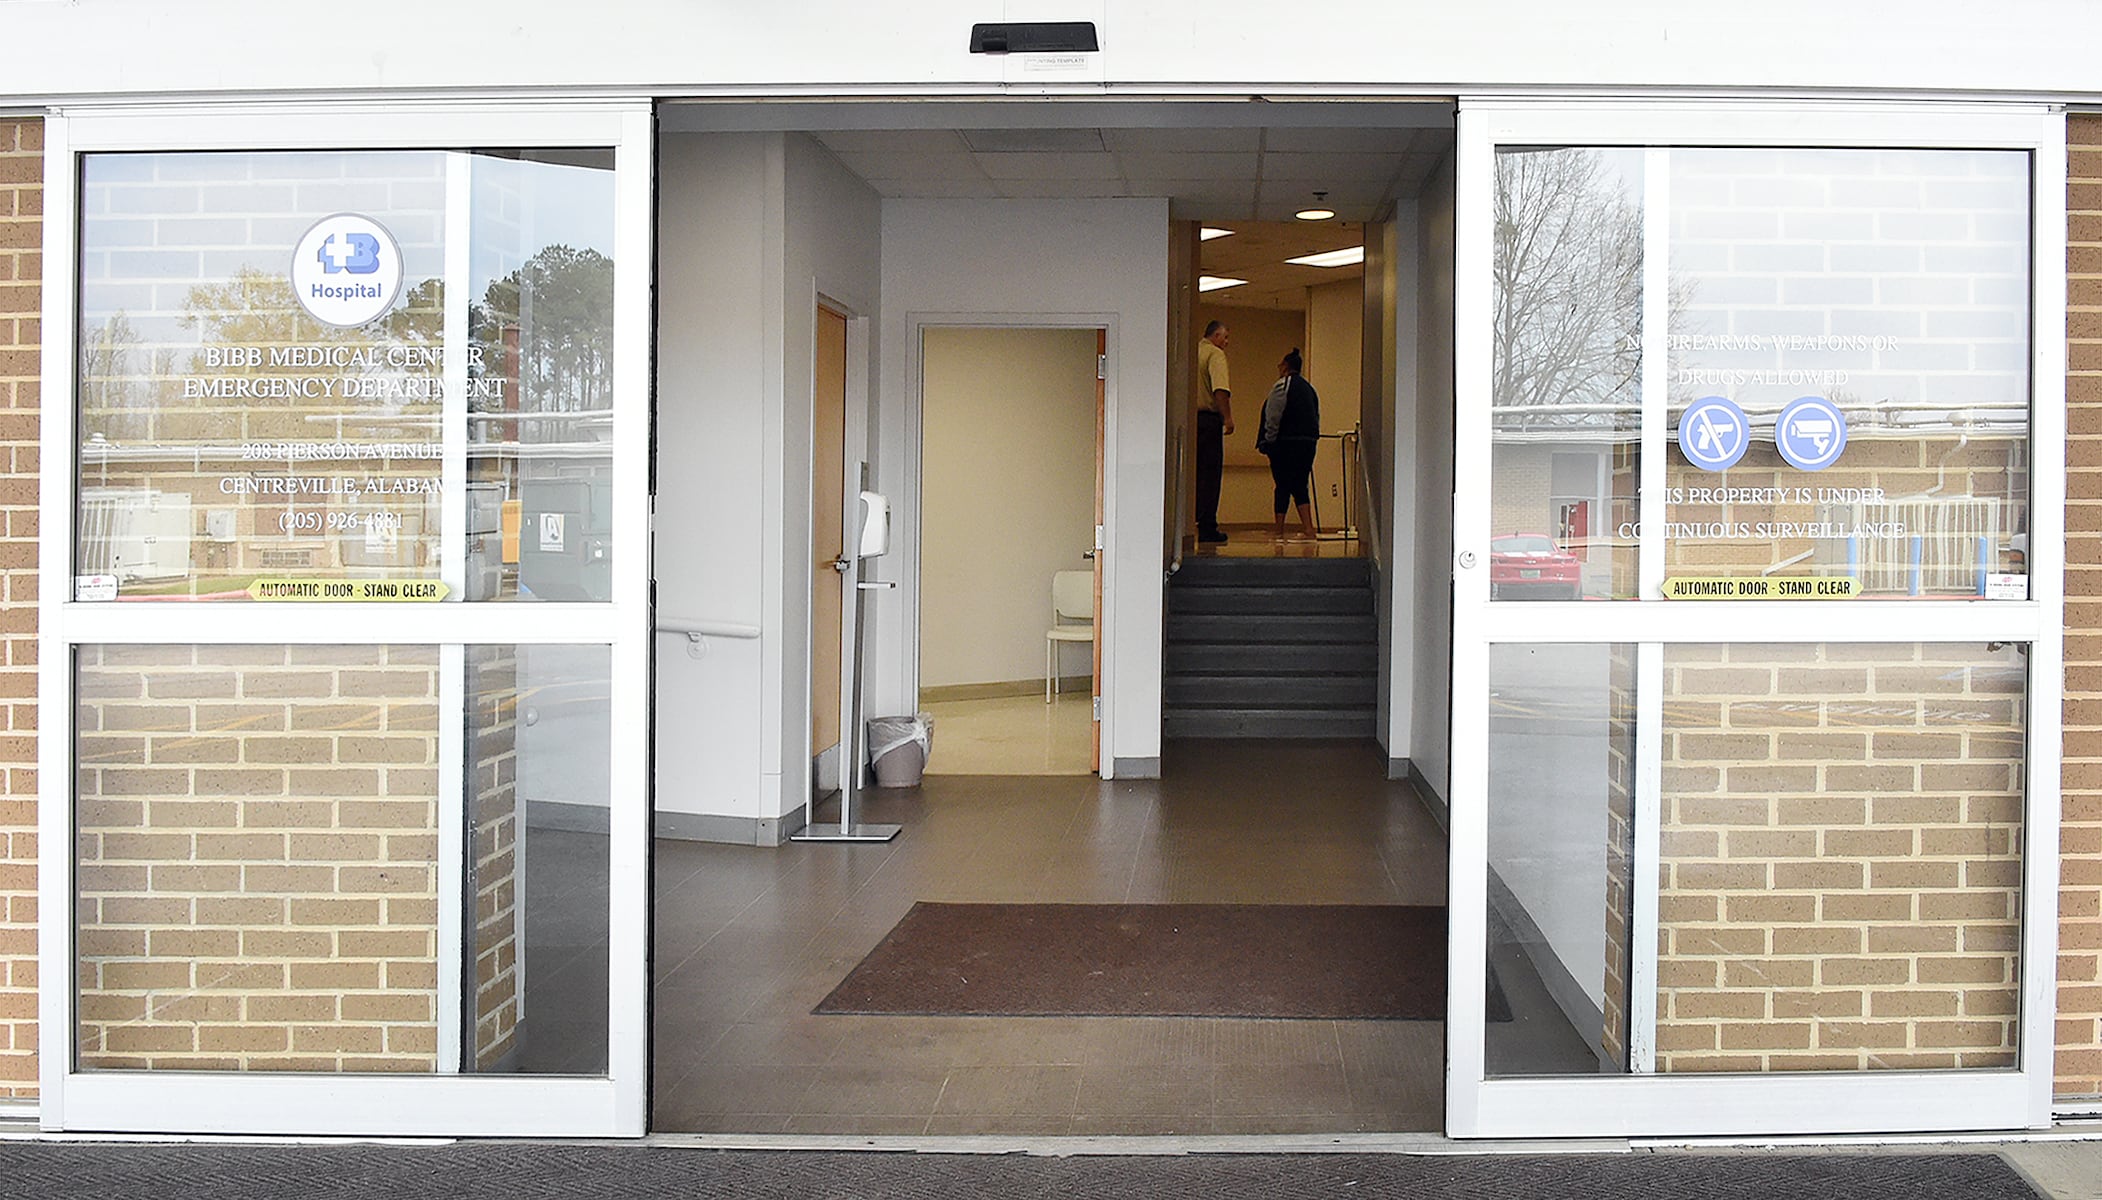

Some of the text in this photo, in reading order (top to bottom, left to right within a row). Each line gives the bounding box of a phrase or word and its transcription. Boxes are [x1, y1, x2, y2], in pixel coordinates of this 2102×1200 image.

[311, 283, 382, 301] Hospital
[1771, 335, 1867, 351] WEAPONS
[1871, 335, 1898, 351] OR
[205, 347, 484, 367] BIBB MEDICAL CENTR
[1679, 368, 1848, 385] DRUGS ALLOWED
[183, 378, 340, 398] EMERGENCY
[242, 443, 444, 459] 208 PIERSON AVENUE
[220, 478, 446, 496] CENTREVILLE, ALABAM
[1688, 488, 1791, 504] PROPERTY
[1795, 488, 1812, 504] IS
[1818, 488, 1886, 504] UNDER
[279, 512, 403, 531] (205) 926-4881
[1755, 522, 1905, 539] SURVEILLANCE
[259, 583, 319, 597] AUTOMATIC
[324, 583, 353, 597] DOOR
[364, 583, 397, 597] STAND
[402, 583, 436, 597] CLEAR
[1673, 582, 1734, 595] AUTOMATIC
[1739, 582, 1768, 595] DOOR
[1779, 582, 1812, 595] STAND
[1818, 581, 1850, 594] CLEAR
